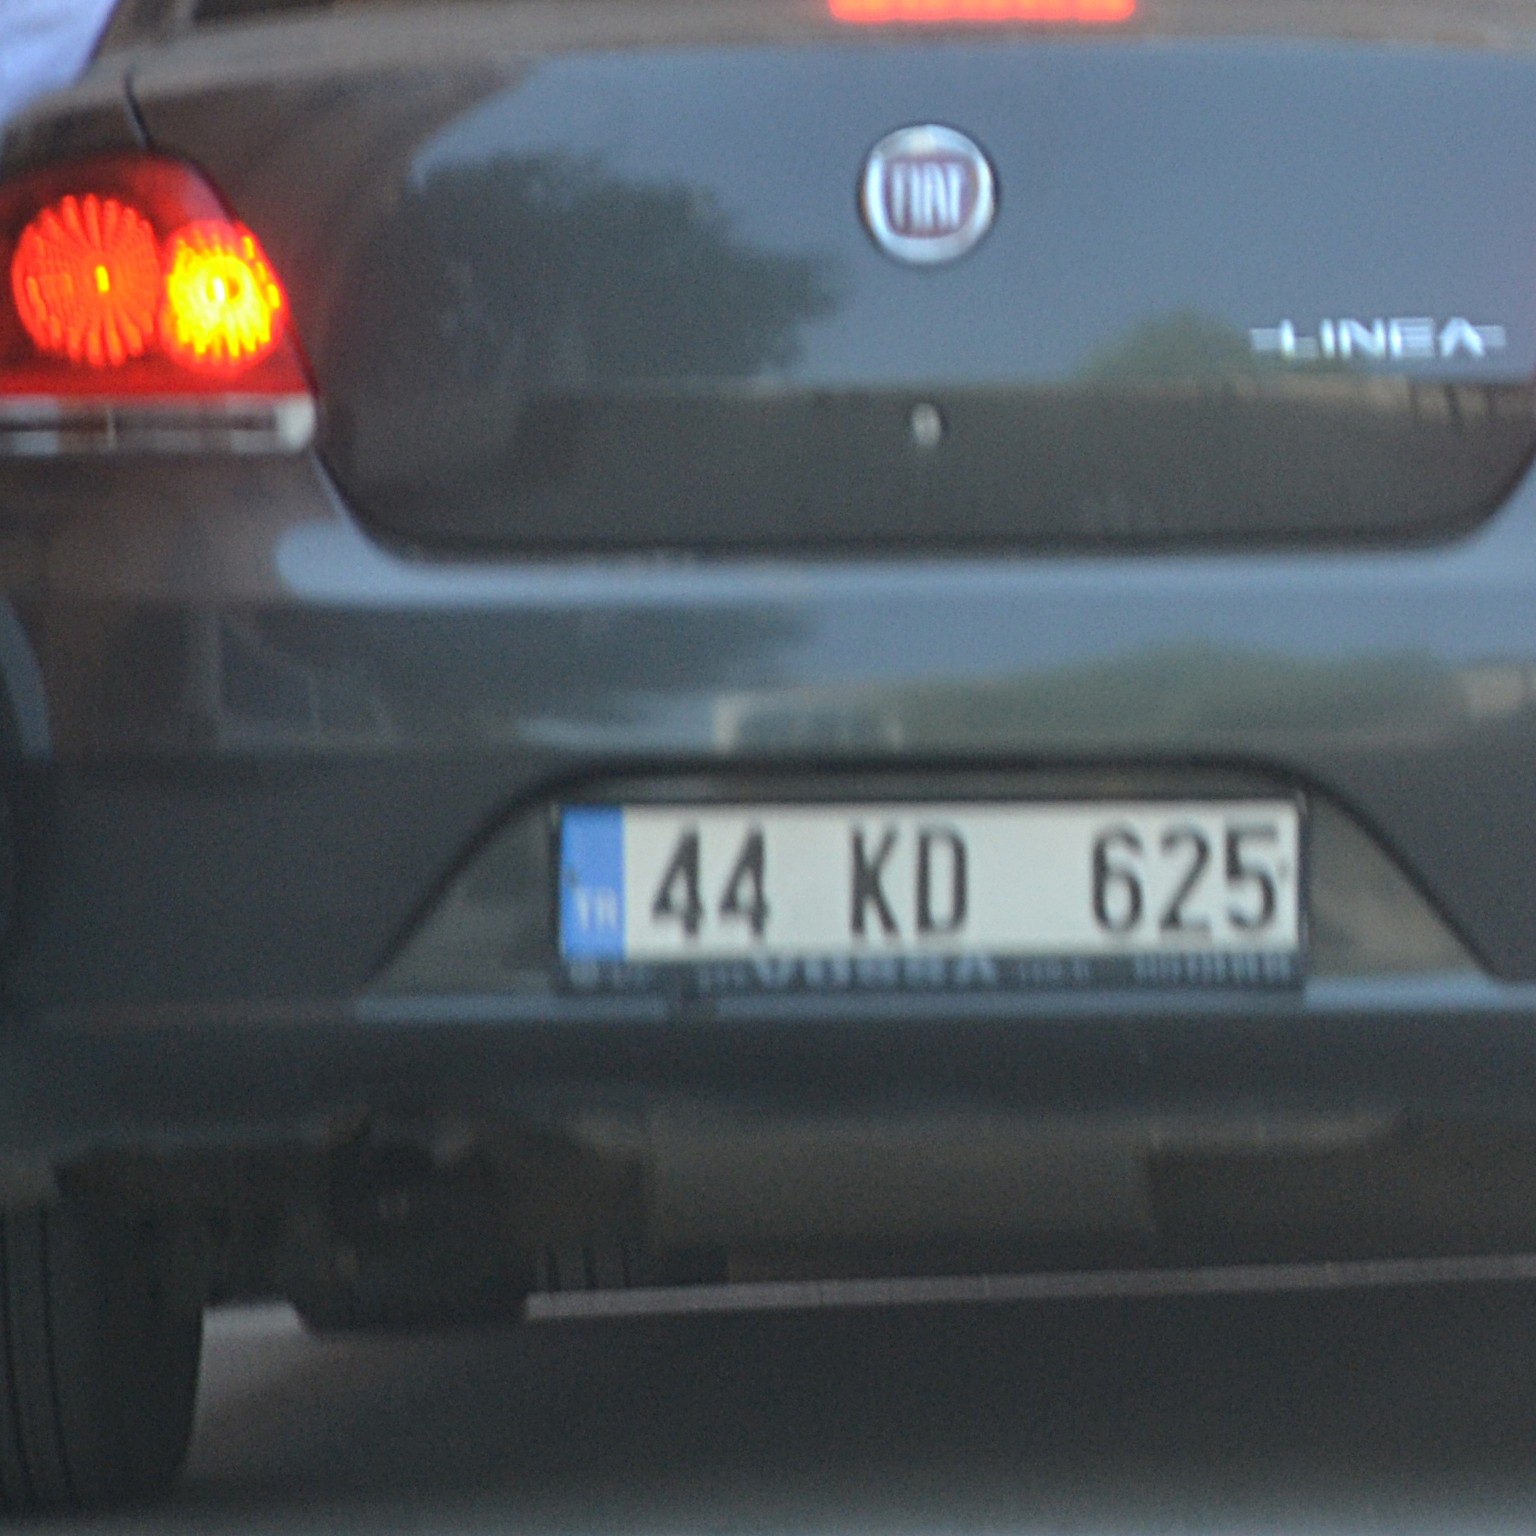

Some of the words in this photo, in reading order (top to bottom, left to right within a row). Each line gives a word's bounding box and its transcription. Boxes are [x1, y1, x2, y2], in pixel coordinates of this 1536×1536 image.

[1258, 317, 1500, 361] LINEA
[650, 825, 769, 938] 44
[849, 826, 969, 938] KD
[1090, 825, 1279, 937] 625
